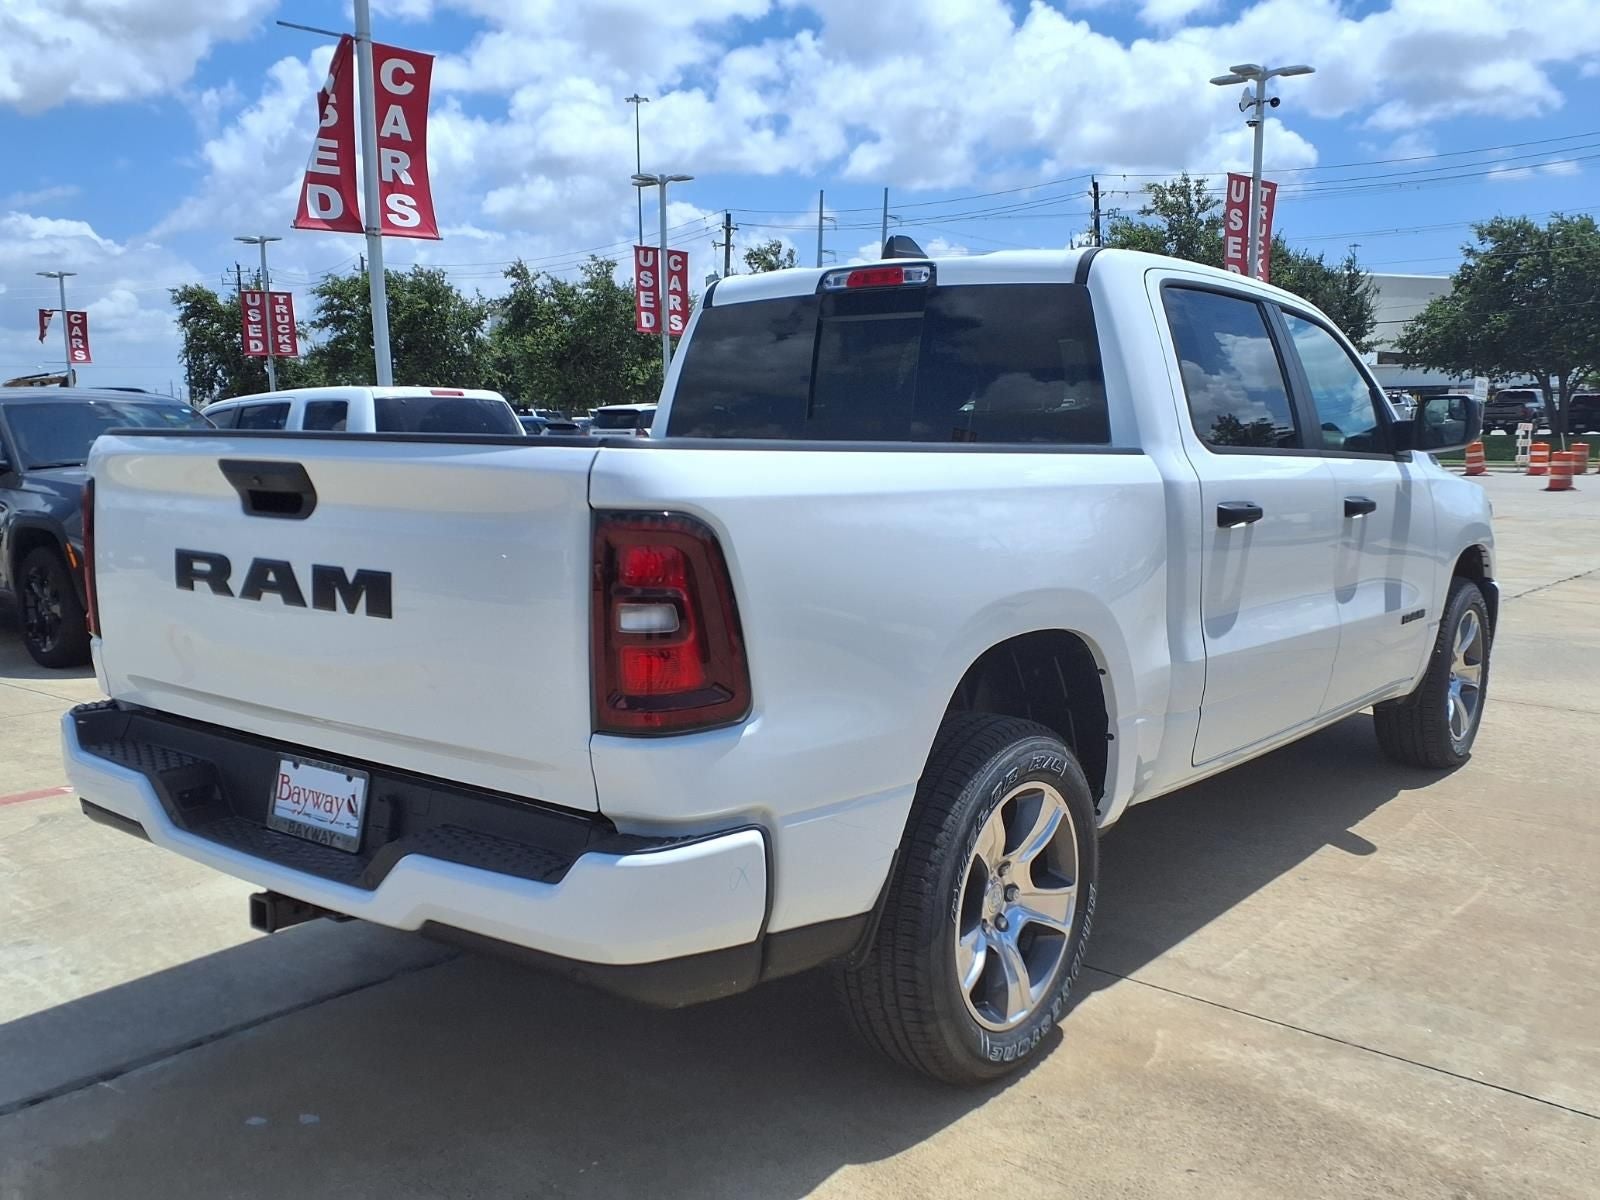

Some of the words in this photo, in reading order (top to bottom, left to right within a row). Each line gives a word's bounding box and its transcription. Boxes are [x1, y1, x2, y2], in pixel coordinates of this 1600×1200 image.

[305, 73, 344, 220] SED
[379, 57, 421, 228] CARS
[1256, 187, 1272, 281] TRUCK
[246, 293, 264, 352] USED
[274, 294, 293, 353] TRUCKS
[639, 249, 656, 328] USED
[668, 254, 683, 331] CARS
[69, 313, 87, 361] CARS
[174, 547, 393, 620] RAM
[276, 772, 345, 825] Bayway
[287, 821, 337, 845] BAYWAY
